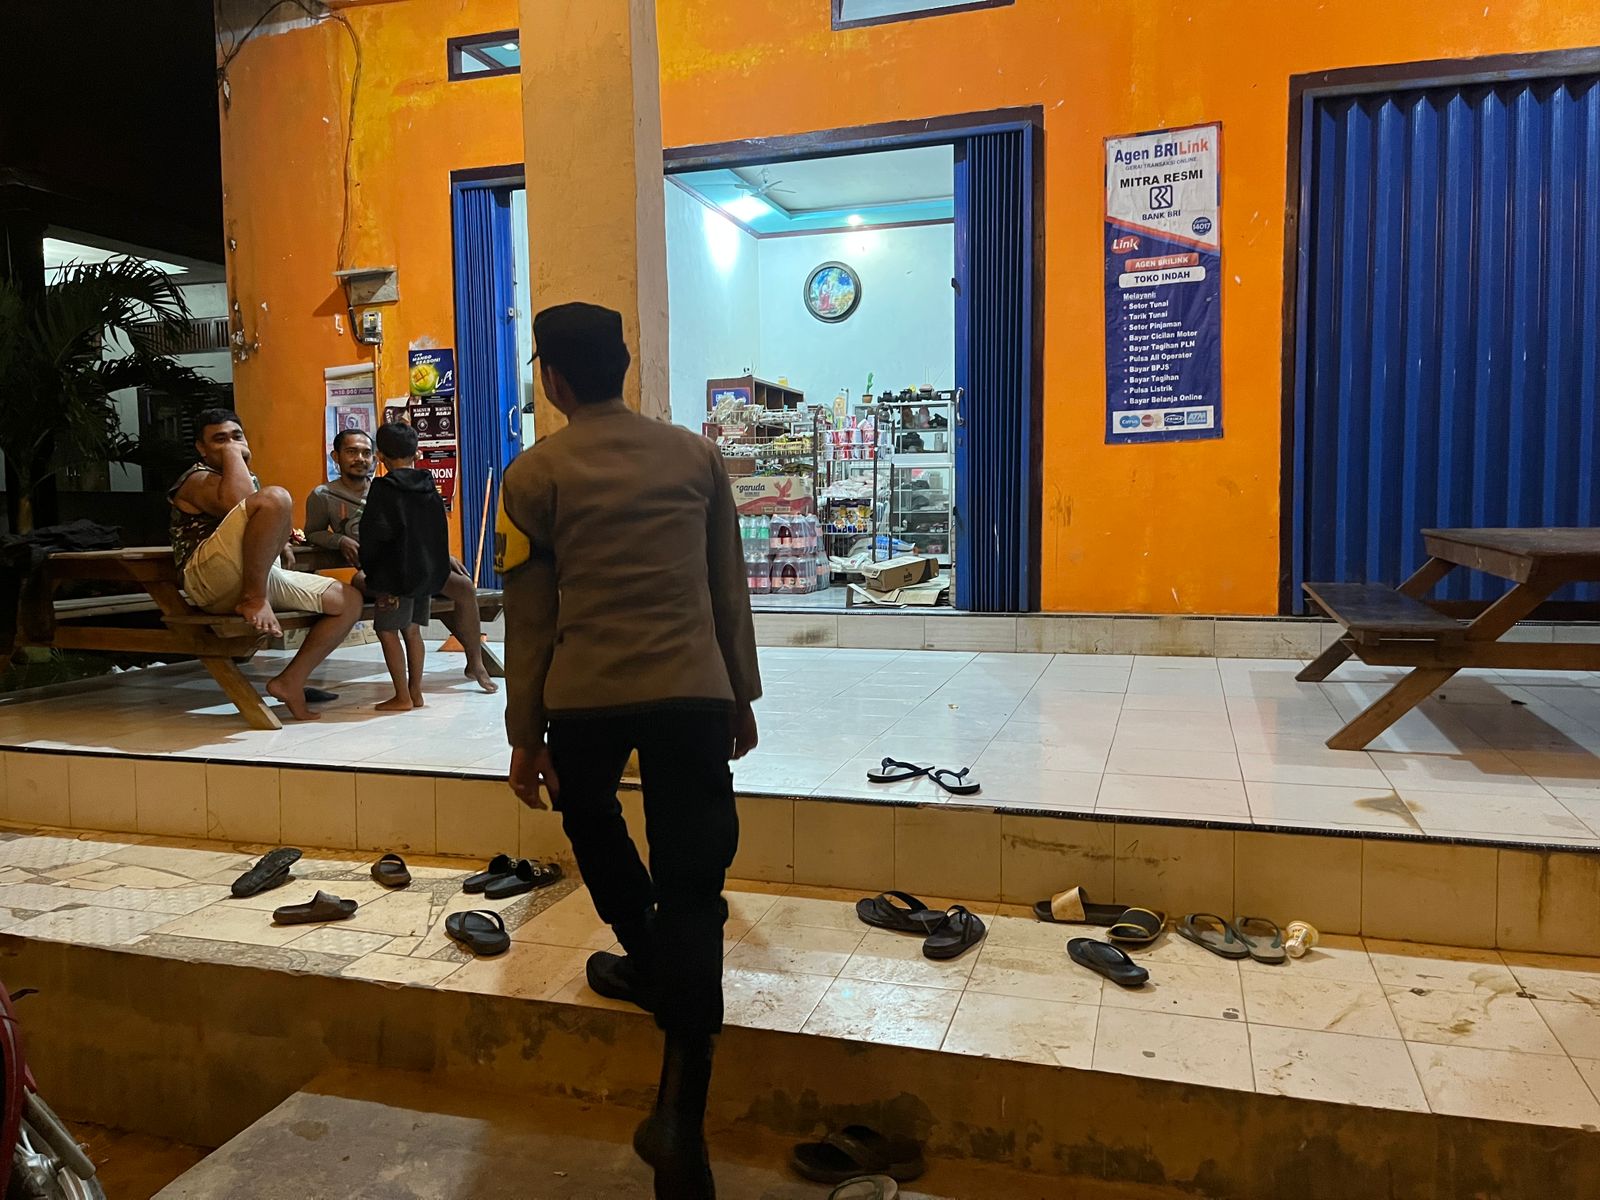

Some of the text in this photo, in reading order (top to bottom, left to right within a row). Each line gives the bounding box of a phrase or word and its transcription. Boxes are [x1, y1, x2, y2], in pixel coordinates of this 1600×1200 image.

[1115, 139, 1208, 164] Agen BRILink
[1120, 170, 1203, 188] MITRA RESMI
[1113, 239, 1139, 250] Link
[1135, 259, 1155, 268] AGEN
[1135, 271, 1190, 283] TOKO INDAH
[1149, 300, 1168, 308] Tunai
[1150, 321, 1181, 330] Pinjaman
[1151, 332, 1175, 340] Cicilan
[1151, 343, 1179, 351] Tagihan
[1161, 352, 1192, 360] Operator
[1129, 366, 1149, 374] Bayar
[1151, 374, 1179, 382] Tagihan
[739, 483, 766, 493] garuda
